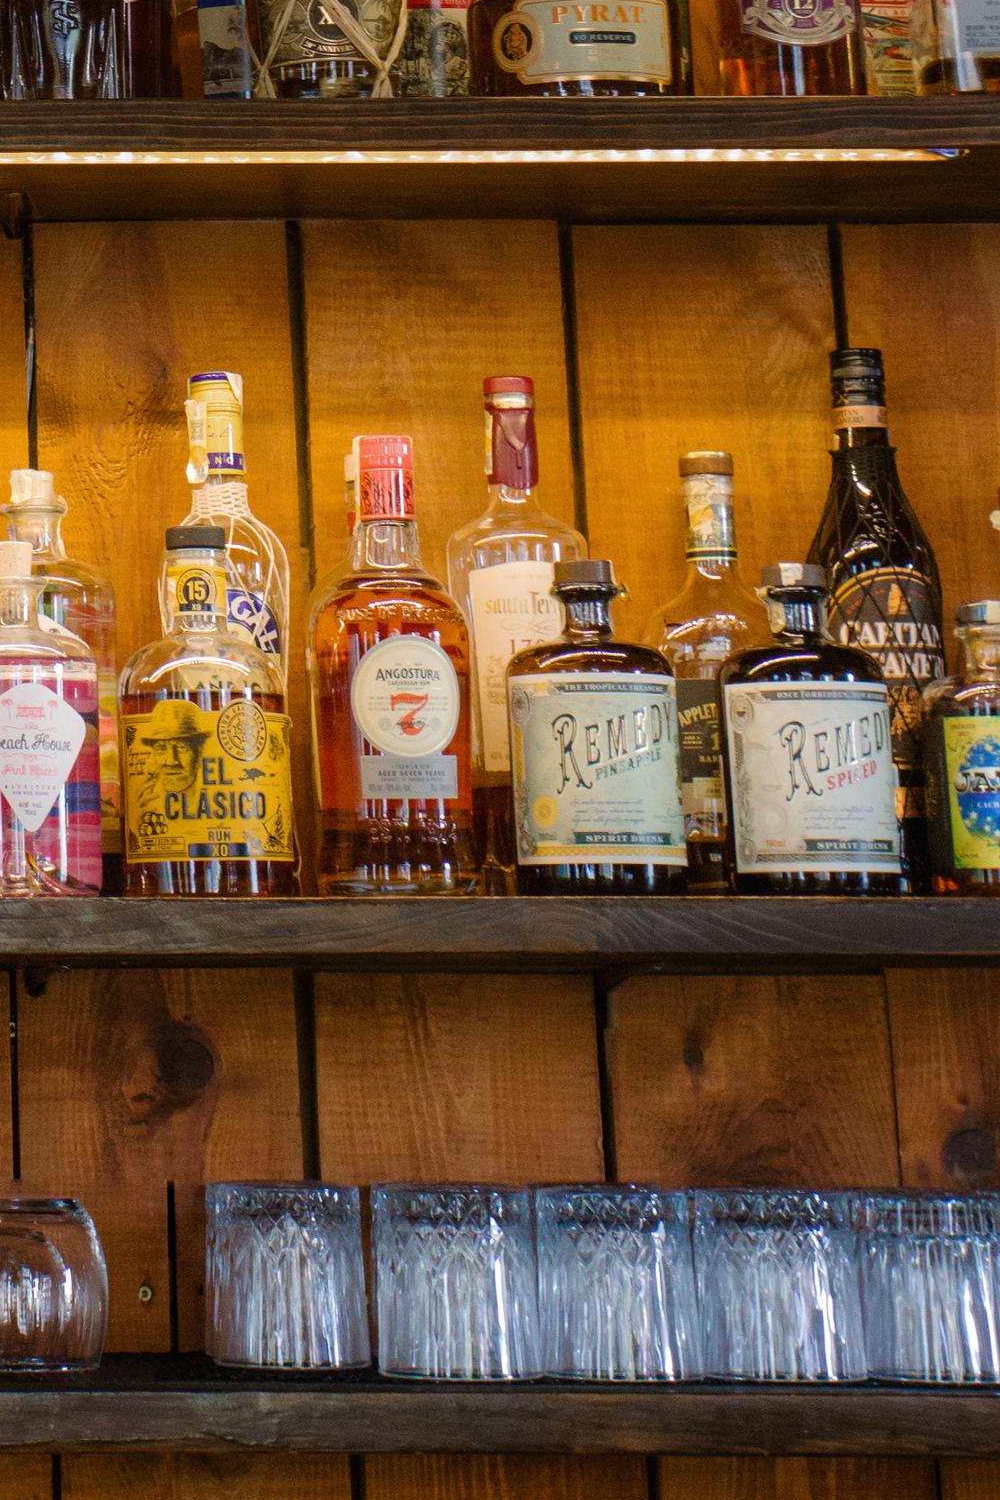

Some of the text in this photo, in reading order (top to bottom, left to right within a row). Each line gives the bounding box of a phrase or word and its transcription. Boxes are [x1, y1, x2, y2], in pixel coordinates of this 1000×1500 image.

[551, 3, 646, 24] PYRAT
[185, 579, 206, 601] 15
[375, 667, 441, 682] ANGOSTURA
[584, 682, 629, 691] TROPICAL
[390, 692, 429, 737] 7
[31, 732, 73, 752] House
[202, 757, 233, 786] EL
[164, 787, 267, 821] CLÁSICO
[207, 831, 231, 841] RUM
[585, 835, 629, 843] SPIRIT
[211, 843, 229, 857] XO
[816, 841, 858, 850] SPIRIT
